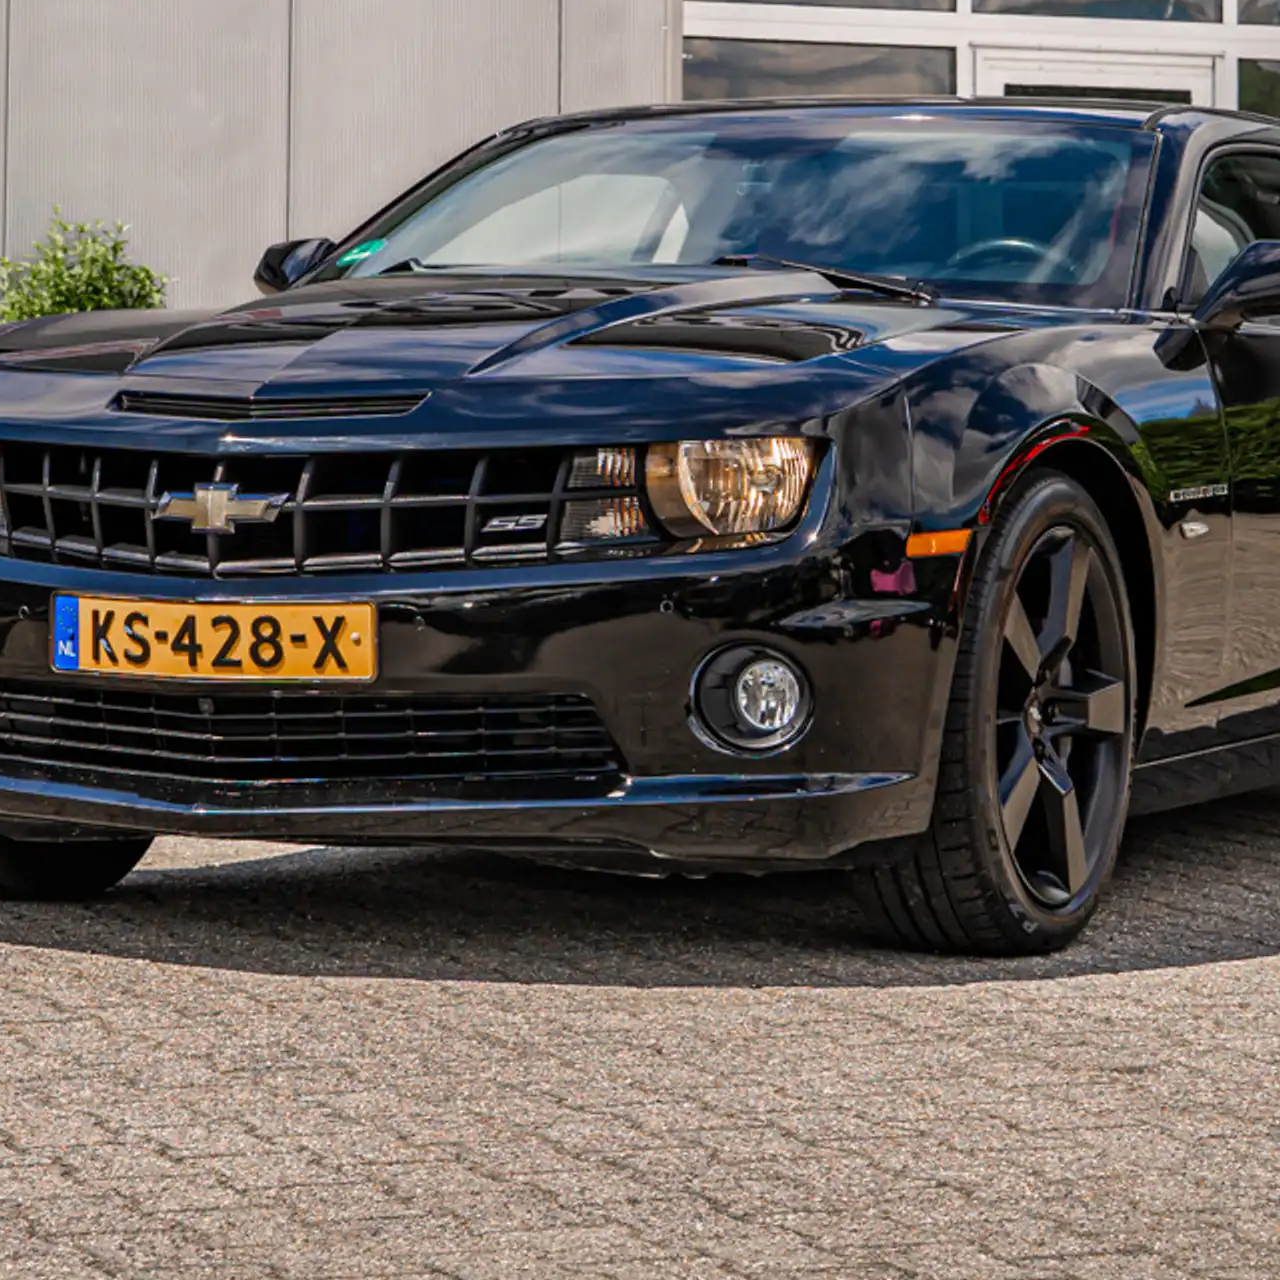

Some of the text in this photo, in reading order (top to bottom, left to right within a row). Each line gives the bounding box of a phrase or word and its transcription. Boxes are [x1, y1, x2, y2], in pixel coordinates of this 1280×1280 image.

[480, 514, 548, 532] SS
[57, 639, 76, 657] NL
[91, 609, 348, 671] KS-428-X
